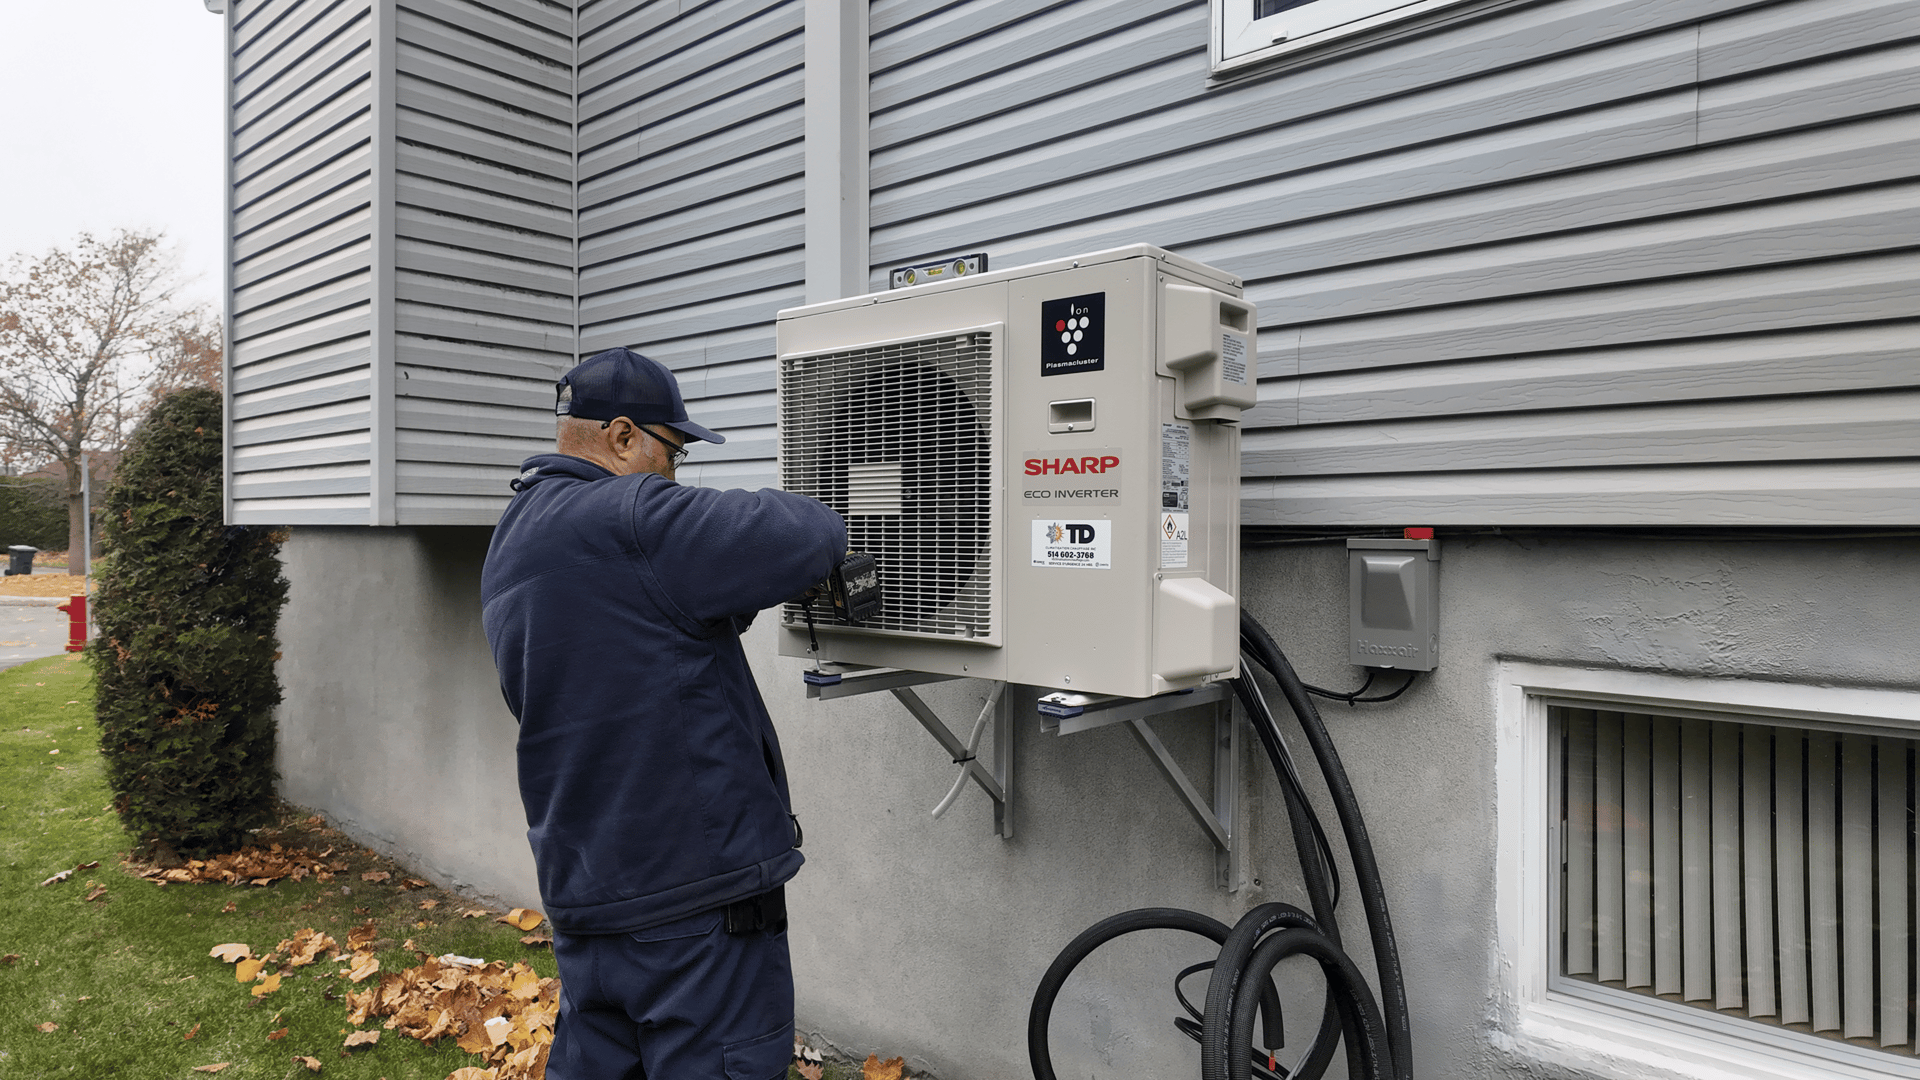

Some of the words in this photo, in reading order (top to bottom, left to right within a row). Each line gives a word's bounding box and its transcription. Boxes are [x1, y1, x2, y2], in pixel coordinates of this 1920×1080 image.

[1070, 303, 1089, 316] Ion
[1045, 358, 1099, 369] Plasmacluster
[1024, 456, 1120, 476] SHARP
[1024, 490, 1051, 499] ECO
[1054, 489, 1119, 498] INVERTER
[1066, 524, 1095, 544] TD
[1176, 530, 1187, 540] A2L
[1060, 551, 1095, 559] 602-3768
[1357, 639, 1419, 659] Haxxair
